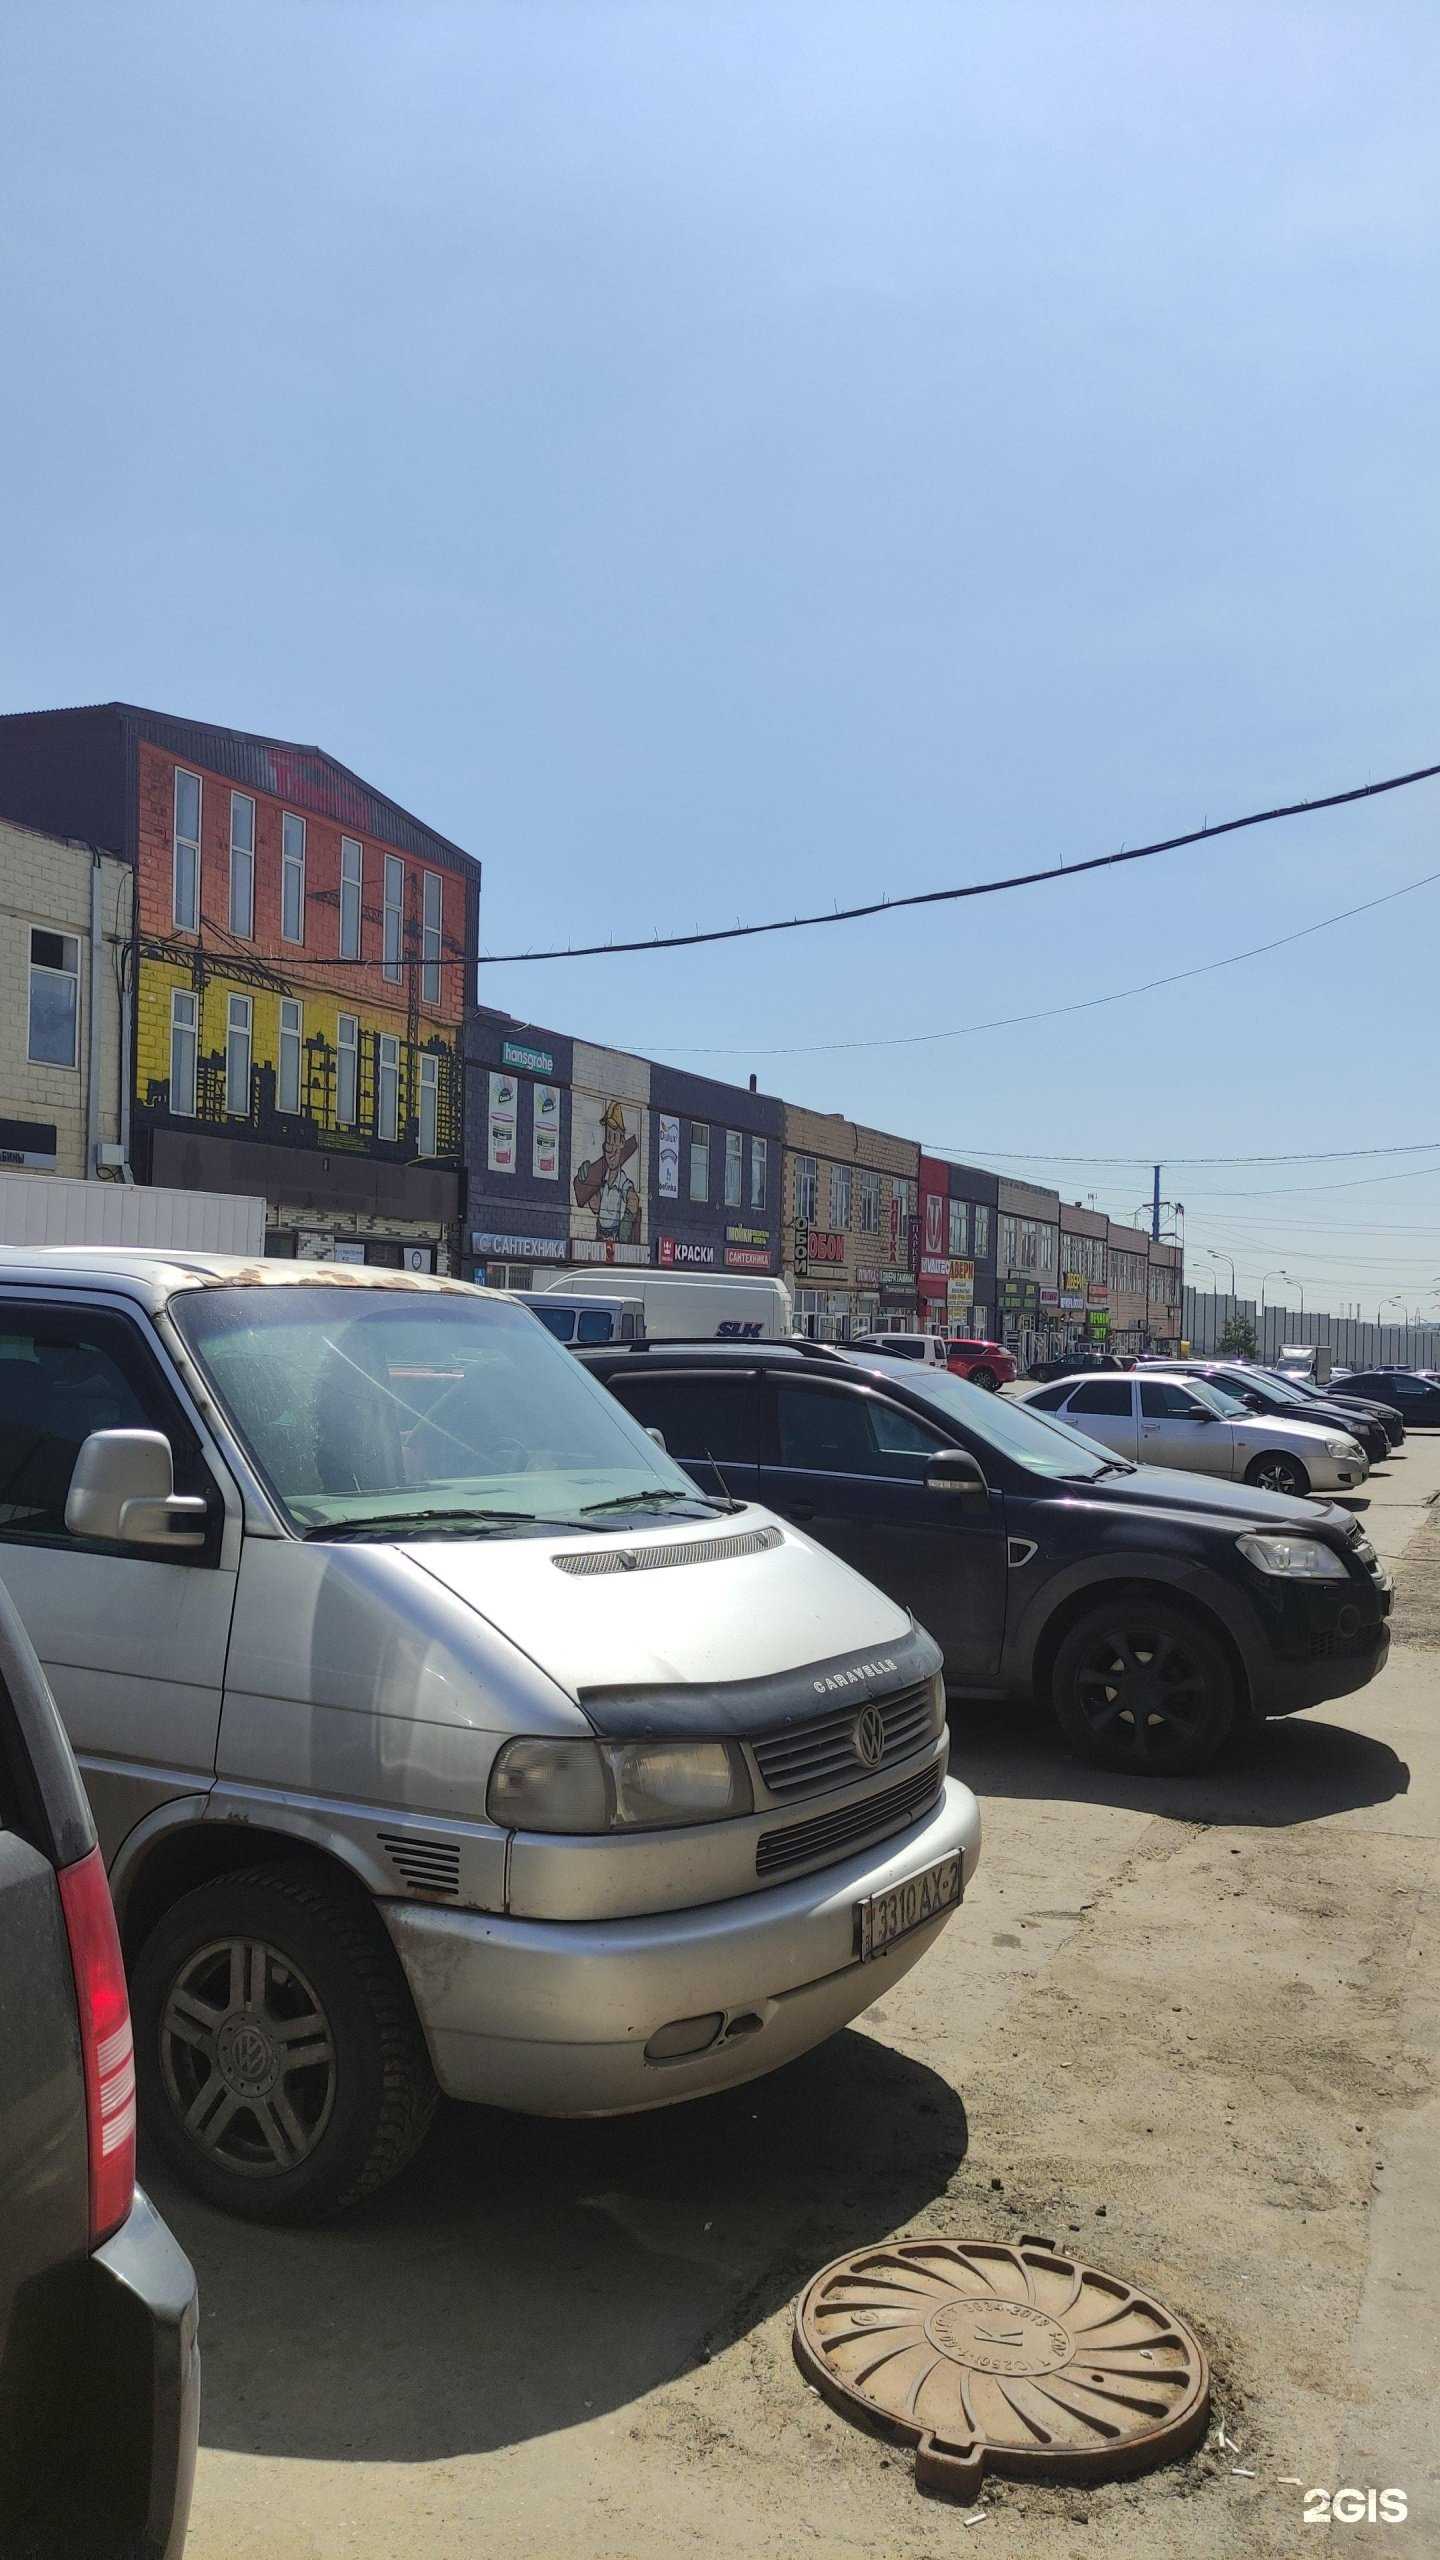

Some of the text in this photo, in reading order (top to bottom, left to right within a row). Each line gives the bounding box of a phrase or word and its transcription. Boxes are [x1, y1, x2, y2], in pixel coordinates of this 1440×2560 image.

[505, 1042, 553, 1070] hansgrohe
[493, 1237, 565, 1258] САНТЕХНИКА
[675, 1244, 714, 1262] КРАСКИ
[729, 1251, 769, 1265] САНТЕХНИКА
[795, 1217, 808, 1274] ОБОИ
[809, 1232, 845, 1260] ОБОИ
[813, 1659, 898, 1693] CARAVELLE
